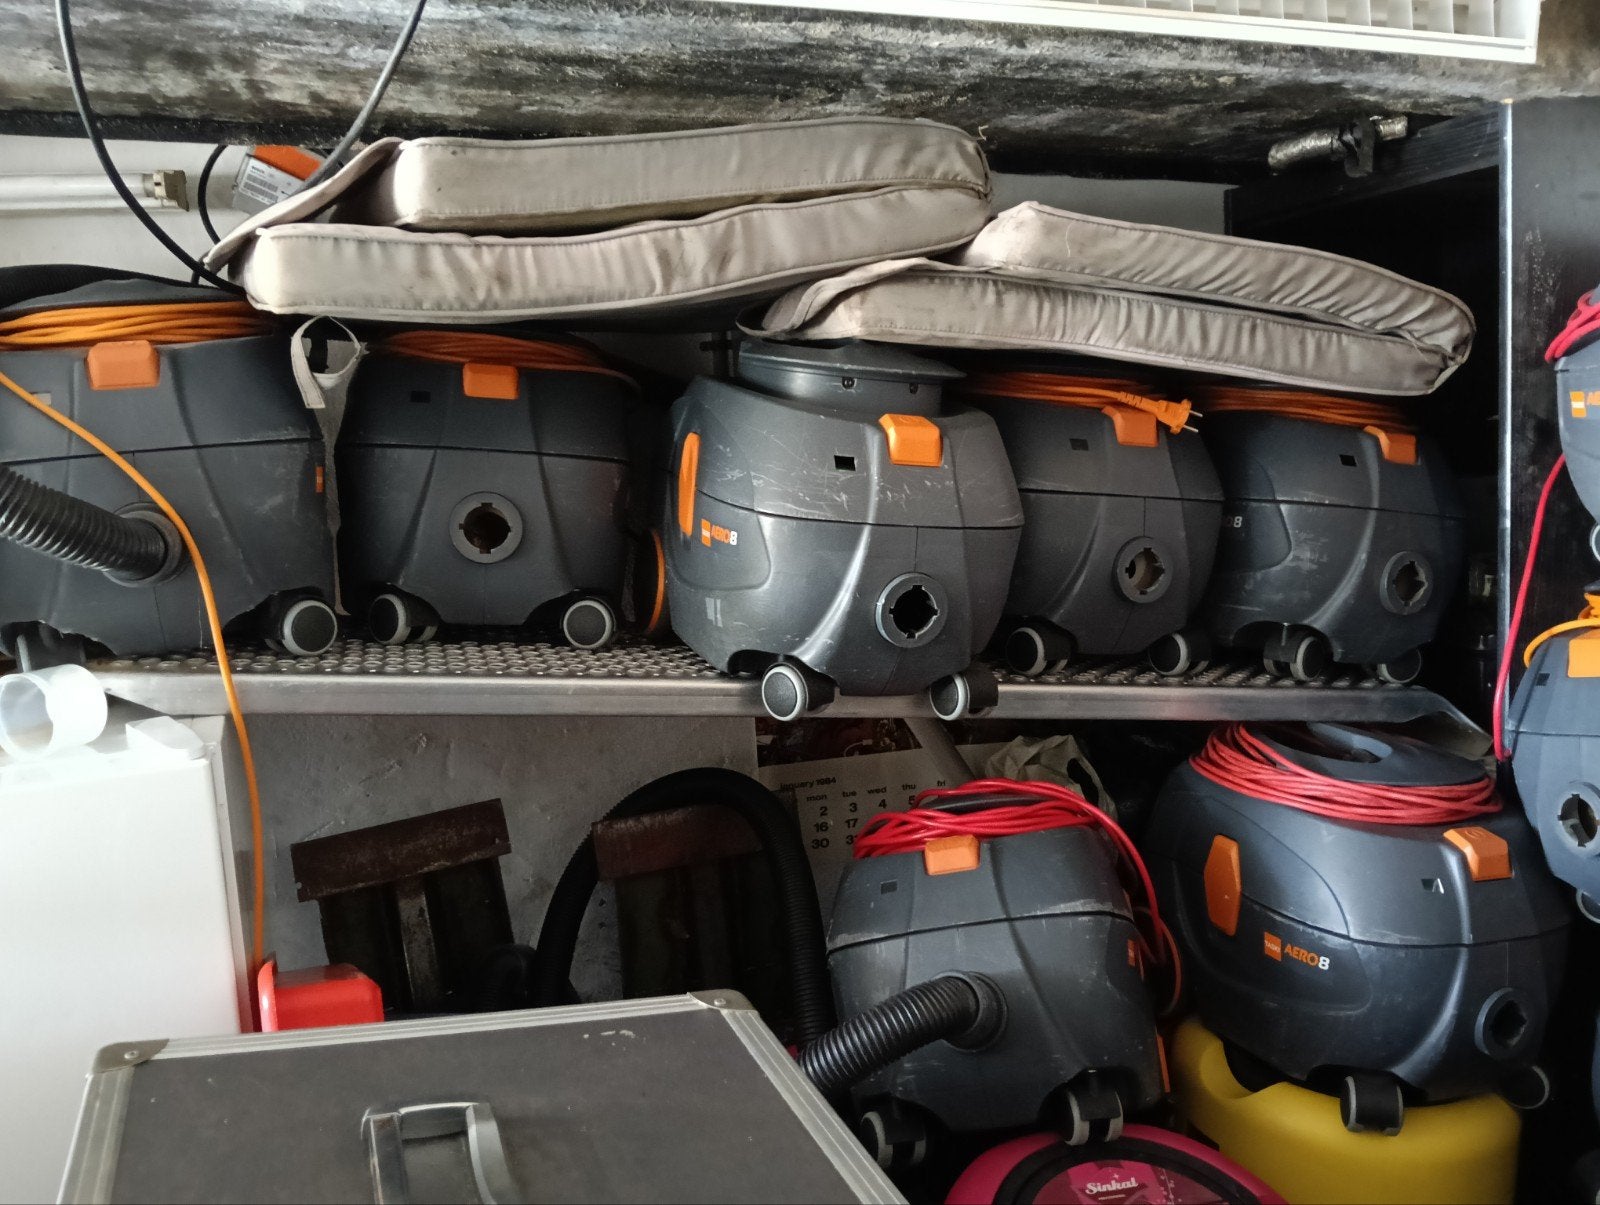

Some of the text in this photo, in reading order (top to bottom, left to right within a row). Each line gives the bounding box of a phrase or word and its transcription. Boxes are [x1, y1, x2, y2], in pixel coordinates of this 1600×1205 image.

[816, 777, 837, 786] 1984
[806, 793, 827, 802] mon
[842, 790, 857, 798] tue
[867, 786, 887, 795] wed
[902, 783, 916, 791] thu
[819, 806, 828, 817] 2
[849, 802, 857, 813] 3
[878, 798, 887, 809] 4
[813, 818, 858, 833] 16 17
[811, 838, 829, 850] 30
[1284, 943, 1331, 971] AERO8
